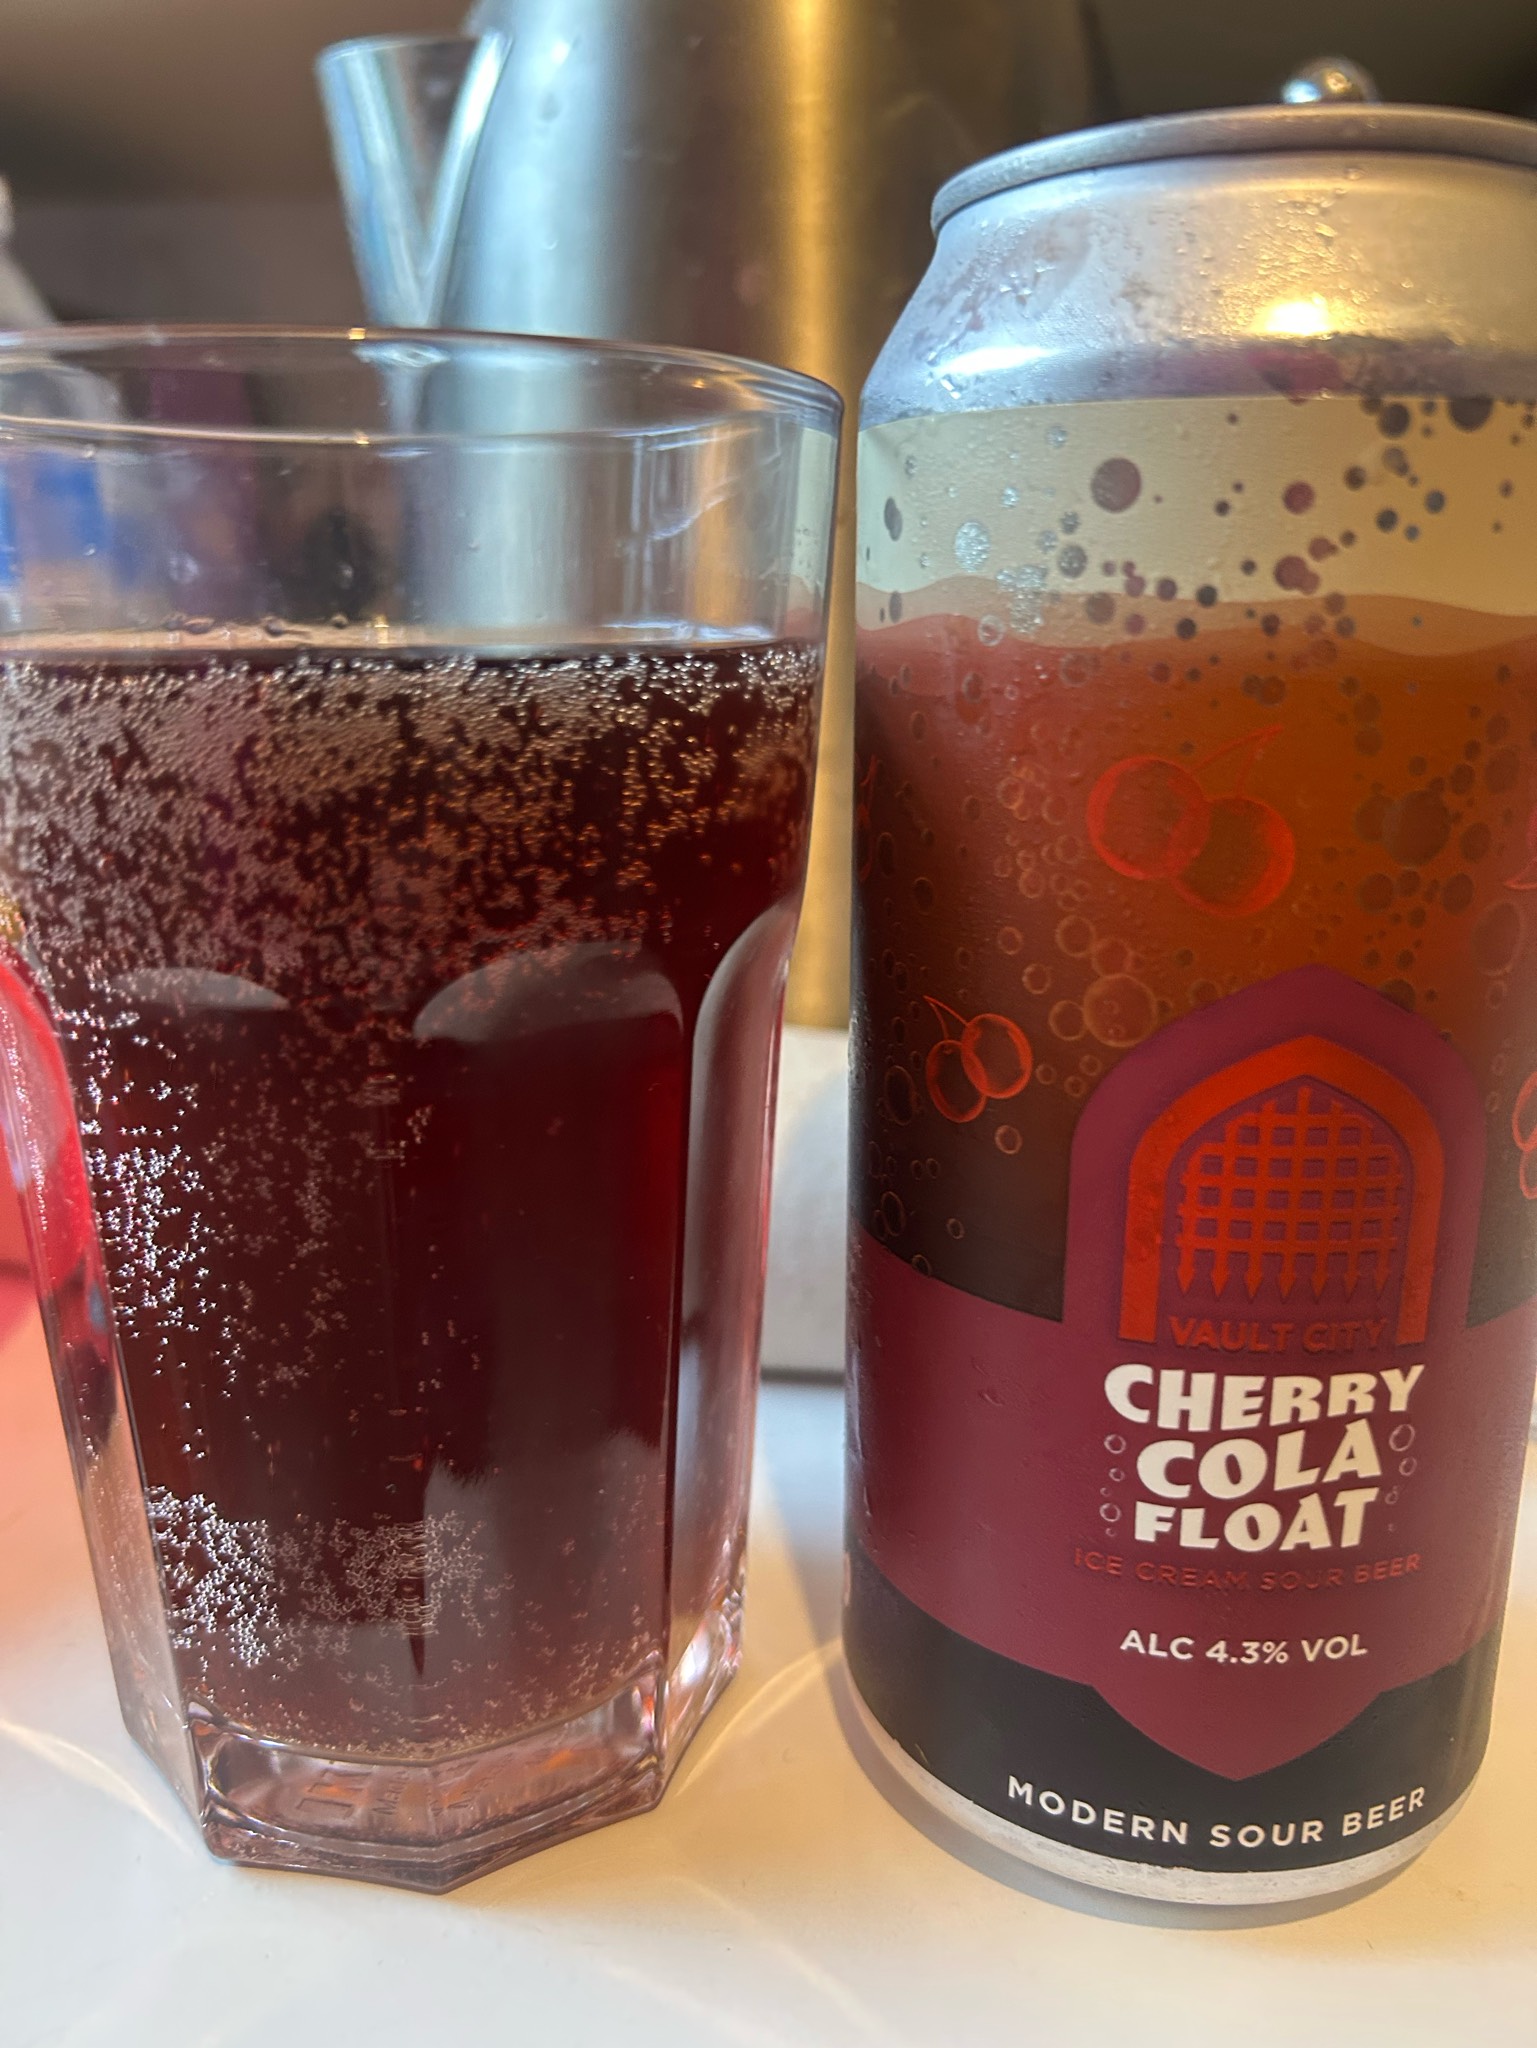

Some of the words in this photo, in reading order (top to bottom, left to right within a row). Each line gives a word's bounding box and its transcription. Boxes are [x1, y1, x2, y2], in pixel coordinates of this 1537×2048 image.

[1169, 1316, 1294, 1351] VAULT
[1303, 1316, 1388, 1351] CITY
[1104, 1363, 1425, 1432] CHERRY
[1136, 1418, 1382, 1499] COLA
[1134, 1487, 1380, 1552] FLOAT
[1074, 1547, 1124, 1576] ICE
[1135, 1560, 1248, 1591] CREAM
[1261, 1567, 1343, 1591] SOUR
[1353, 1553, 1422, 1584] BEER
[1120, 1629, 1195, 1660] ALC
[1205, 1639, 1290, 1664] 4.3%
[1301, 1633, 1369, 1662] VOL
[1007, 1774, 1189, 1845] MODERN
[1209, 1819, 1324, 1849] SOUR
[1341, 1786, 1426, 1837] BEER
